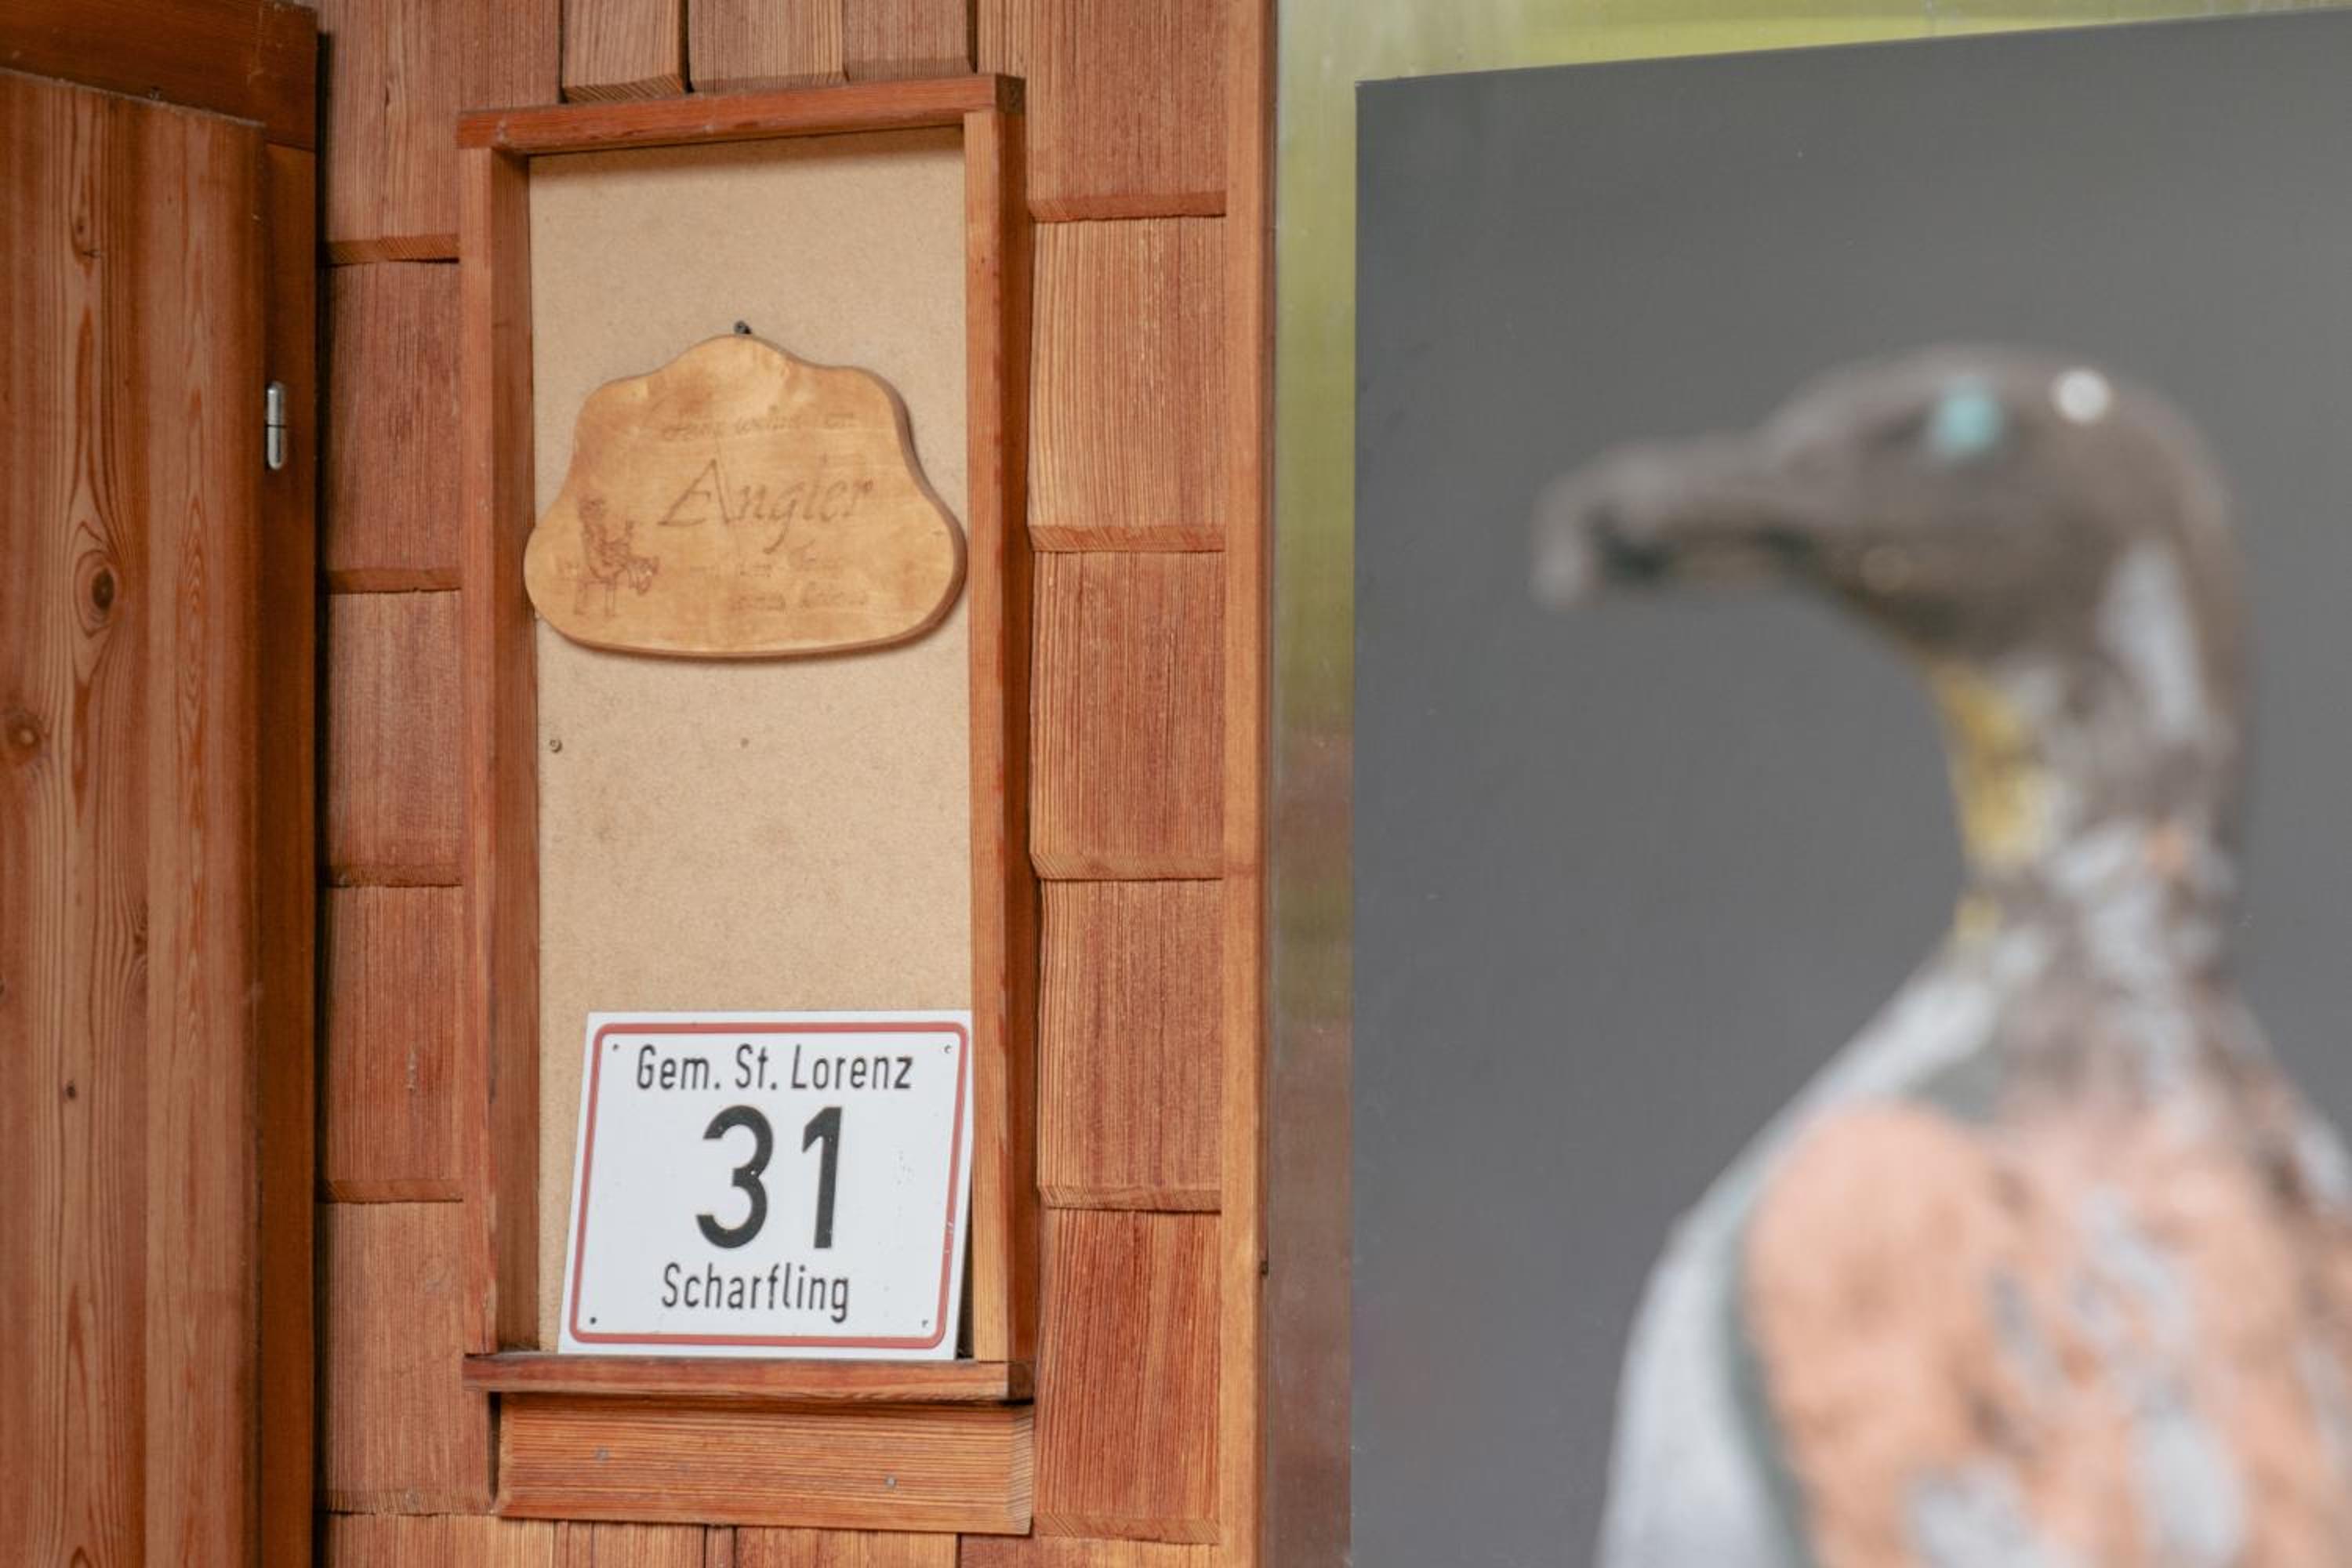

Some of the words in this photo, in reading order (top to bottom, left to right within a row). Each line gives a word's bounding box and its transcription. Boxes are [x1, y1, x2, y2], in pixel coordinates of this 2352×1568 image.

[657, 457, 873, 554] Angler
[637, 1044, 720, 1091] Gem.
[735, 1043, 777, 1091] St.
[791, 1044, 913, 1091] Lorenz
[696, 1104, 843, 1250] 31
[661, 1261, 849, 1323] Scharfling
